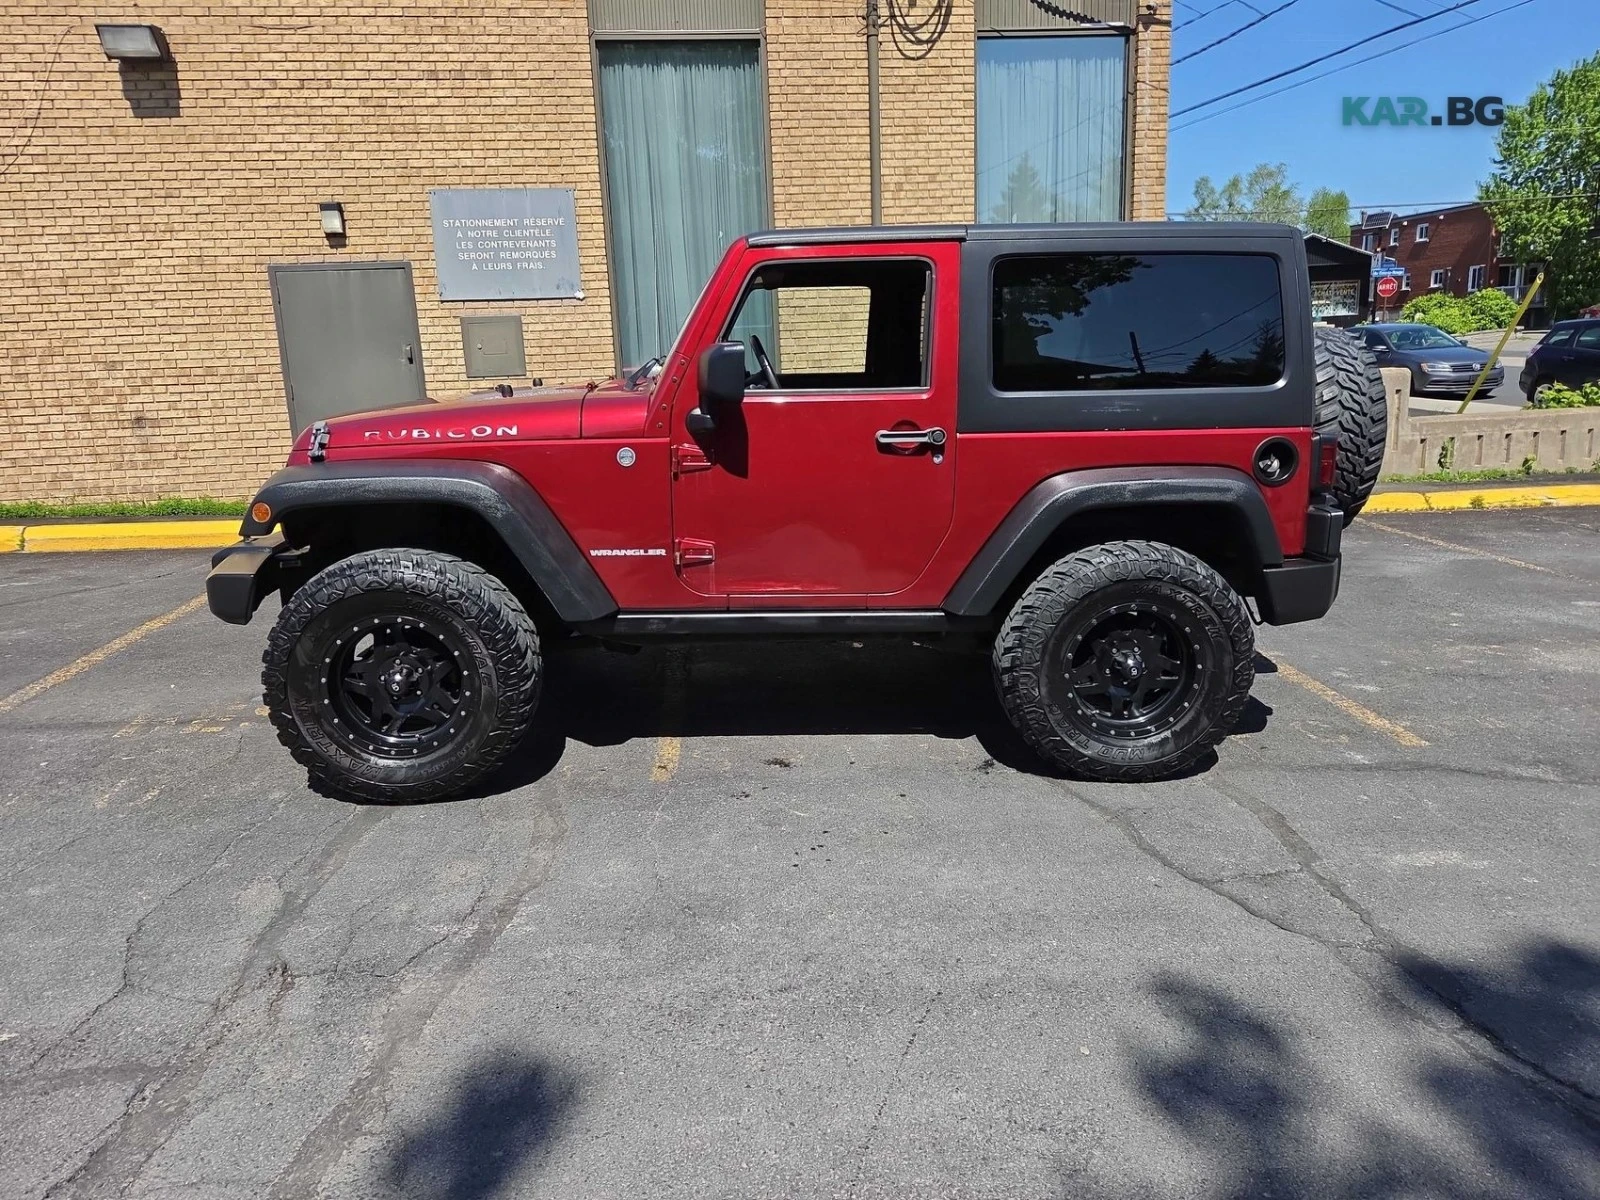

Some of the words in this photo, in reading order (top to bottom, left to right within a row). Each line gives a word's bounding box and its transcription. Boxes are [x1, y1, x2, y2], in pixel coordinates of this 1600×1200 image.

[442, 218, 519, 228] STATIONNEMENT
[456, 229, 463, 238] À
[467, 229, 499, 238] NOTRE
[455, 240, 474, 249] LES
[477, 239, 557, 249] CONTREVENANTS
[457, 251, 495, 260] SERONT
[499, 249, 557, 260] REMORQUÉS
[471, 261, 478, 271] À
[482, 261, 513, 271] LEURS
[516, 261, 546, 270] FRAIS.
[1379, 282, 1397, 290] ARRÊT
[363, 424, 518, 441] RUBICON
[589, 548, 667, 557] WRANGLER
